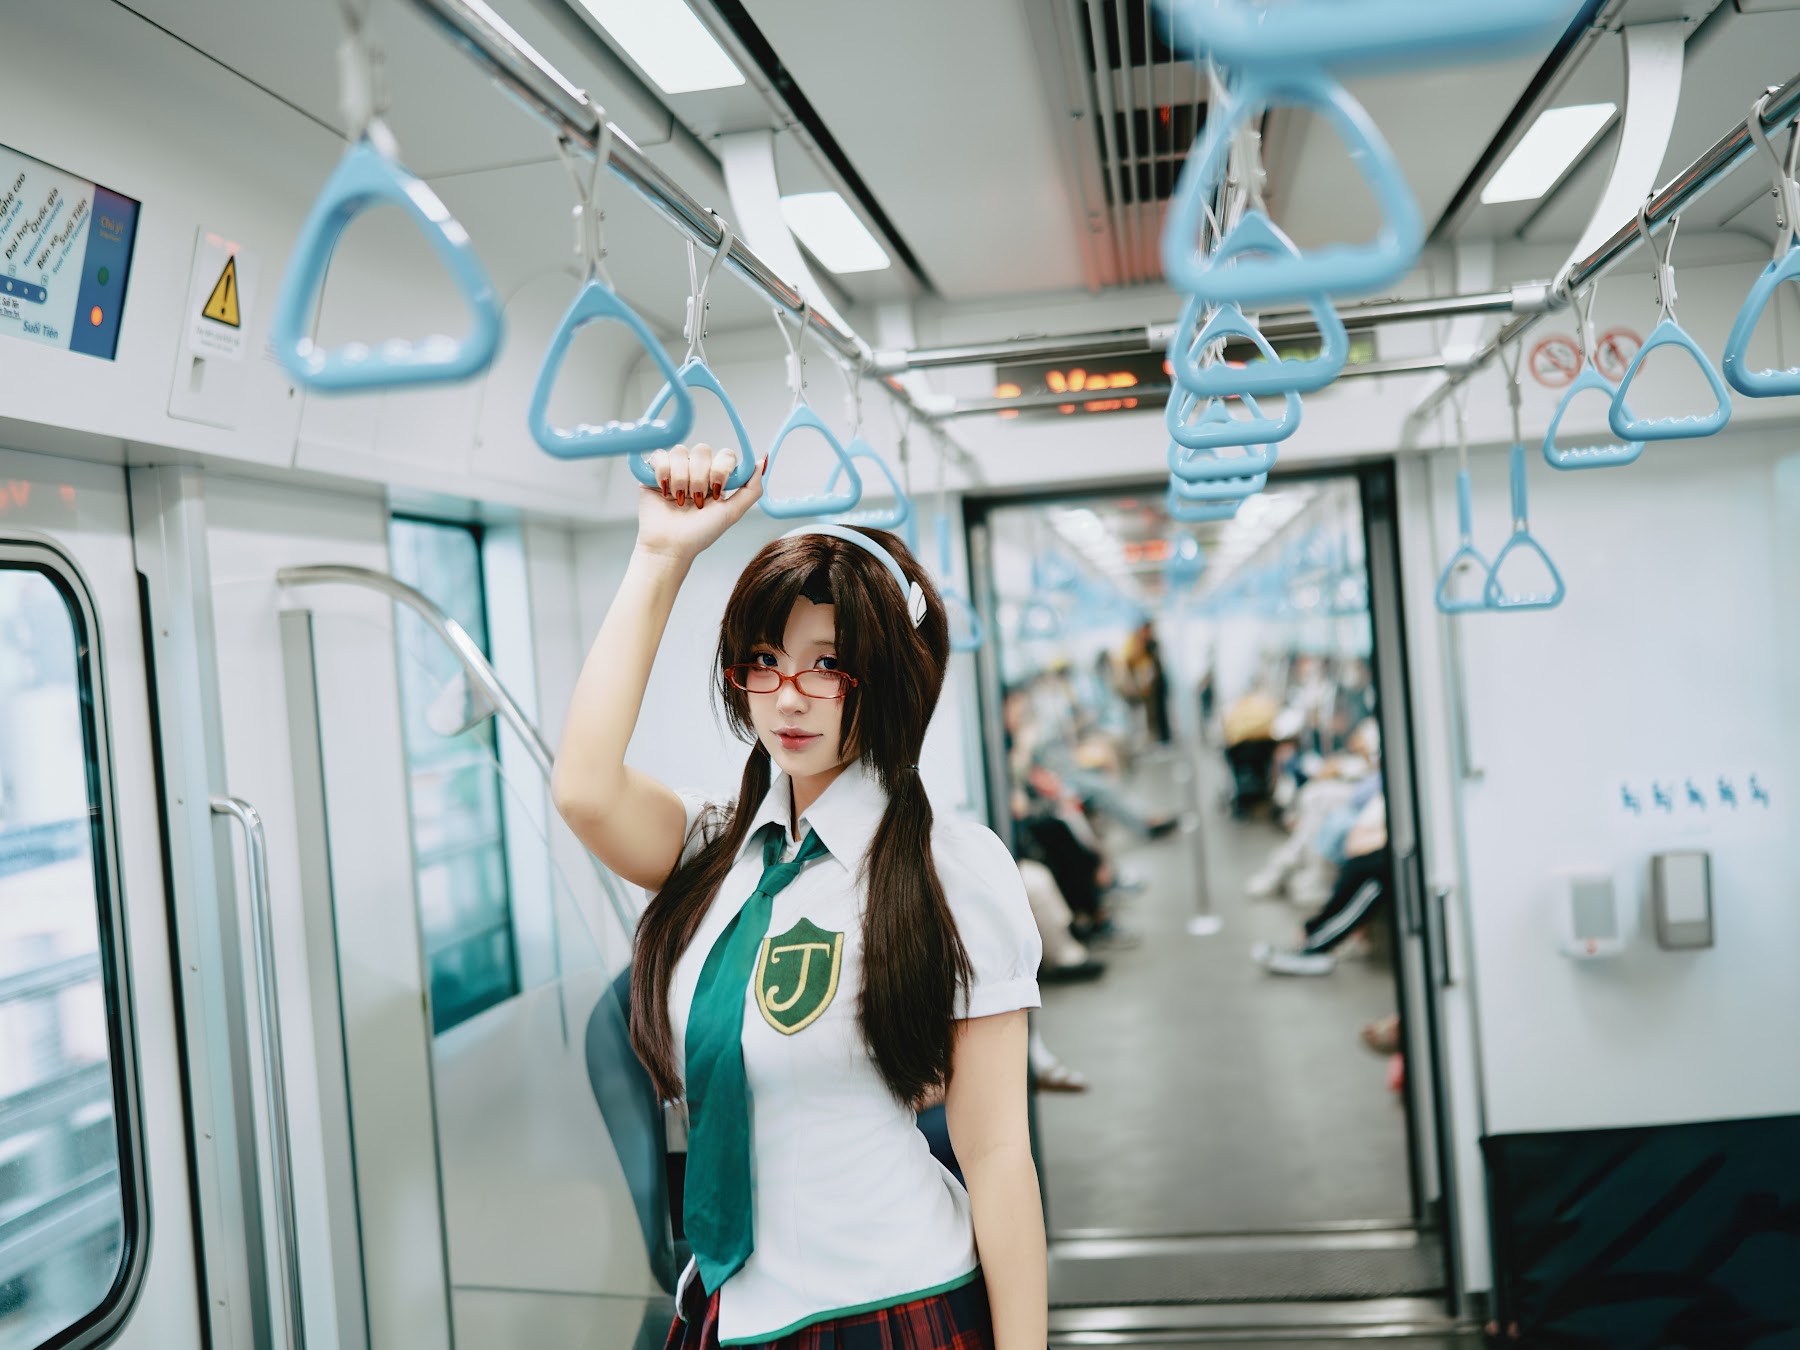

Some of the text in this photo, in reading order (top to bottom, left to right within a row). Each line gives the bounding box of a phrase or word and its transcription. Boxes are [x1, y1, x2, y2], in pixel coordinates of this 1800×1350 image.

[14, 172, 26, 193] cao
[1, 200, 23, 235] Tech Park
[31, 187, 59, 233] Quốc gia
[59, 198, 88, 245] Suối Tiên
[5, 240, 19, 260] Đại
[16, 219, 31, 240] học
[23, 197, 64, 268] National University
[37, 247, 51, 270] Bến
[50, 235, 59, 249] xe
[52, 257, 64, 274] Suoi
[62, 241, 73, 257] Tien
[23, 320, 59, 339] Suối Tiên
[765, 943, 830, 1012] J
